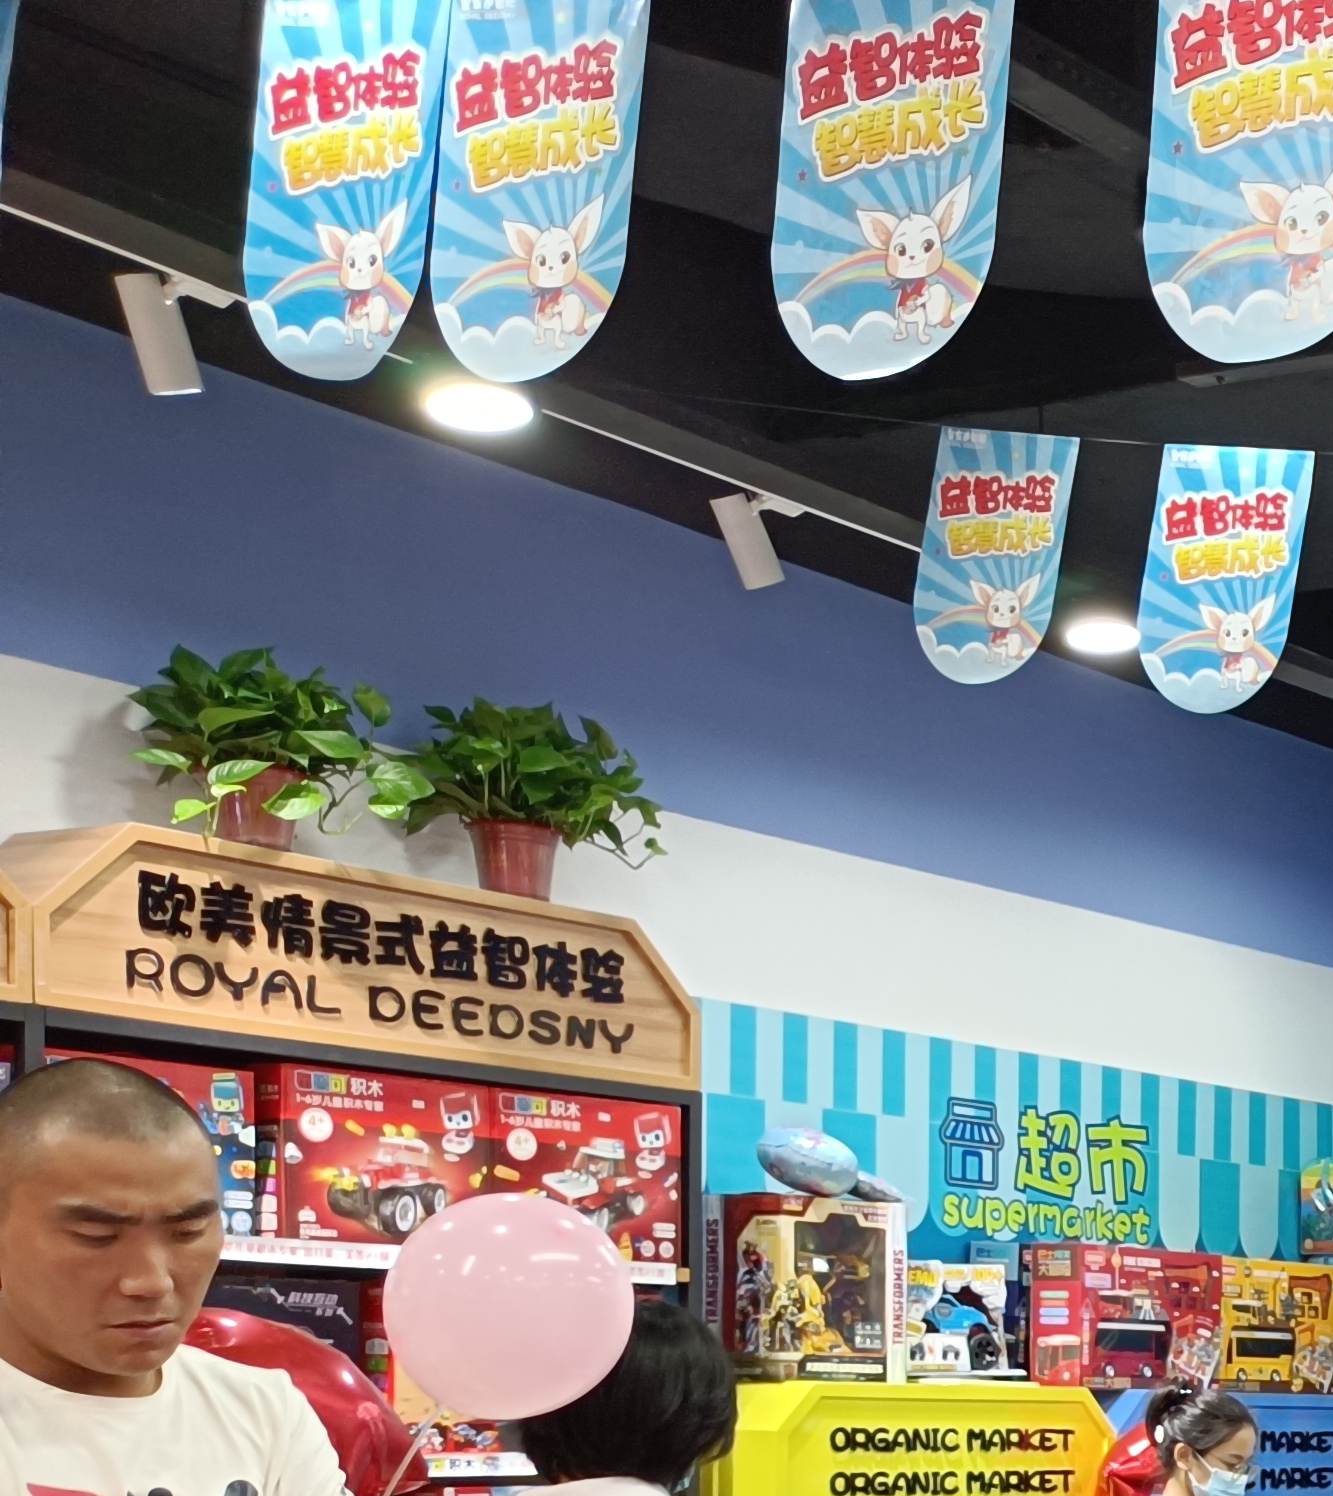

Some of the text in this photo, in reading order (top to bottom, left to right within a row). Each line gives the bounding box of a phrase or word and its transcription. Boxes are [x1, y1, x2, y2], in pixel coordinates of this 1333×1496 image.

[272, 50, 419, 133] 益智体验
[457, 41, 615, 131] 益智体验
[799, 13, 983, 120] 益智体验
[284, 112, 420, 189] 智慧成长
[469, 106, 617, 188] 智慧成长
[815, 81, 985, 178] 智慧成长
[939, 475, 1054, 518] 益智体验
[947, 514, 1051, 557] 智慧成长
[1165, 493, 1287, 541] 益智体验
[1174, 534, 1286, 581] 智慧成长
[137, 869, 625, 1004] 欧美情景式益智体验
[125, 947, 634, 1054] ROYAL DEEDSNY
[1014, 1105, 1150, 1204] 超市
[941, 1190, 1152, 1247] supermarket
[892, 1249, 905, 1345] TRANSFORMERS
[829, 1426, 1076, 1455] ORGANIC MARKET
[829, 1470, 1076, 1496] ORGANIC MARKET
